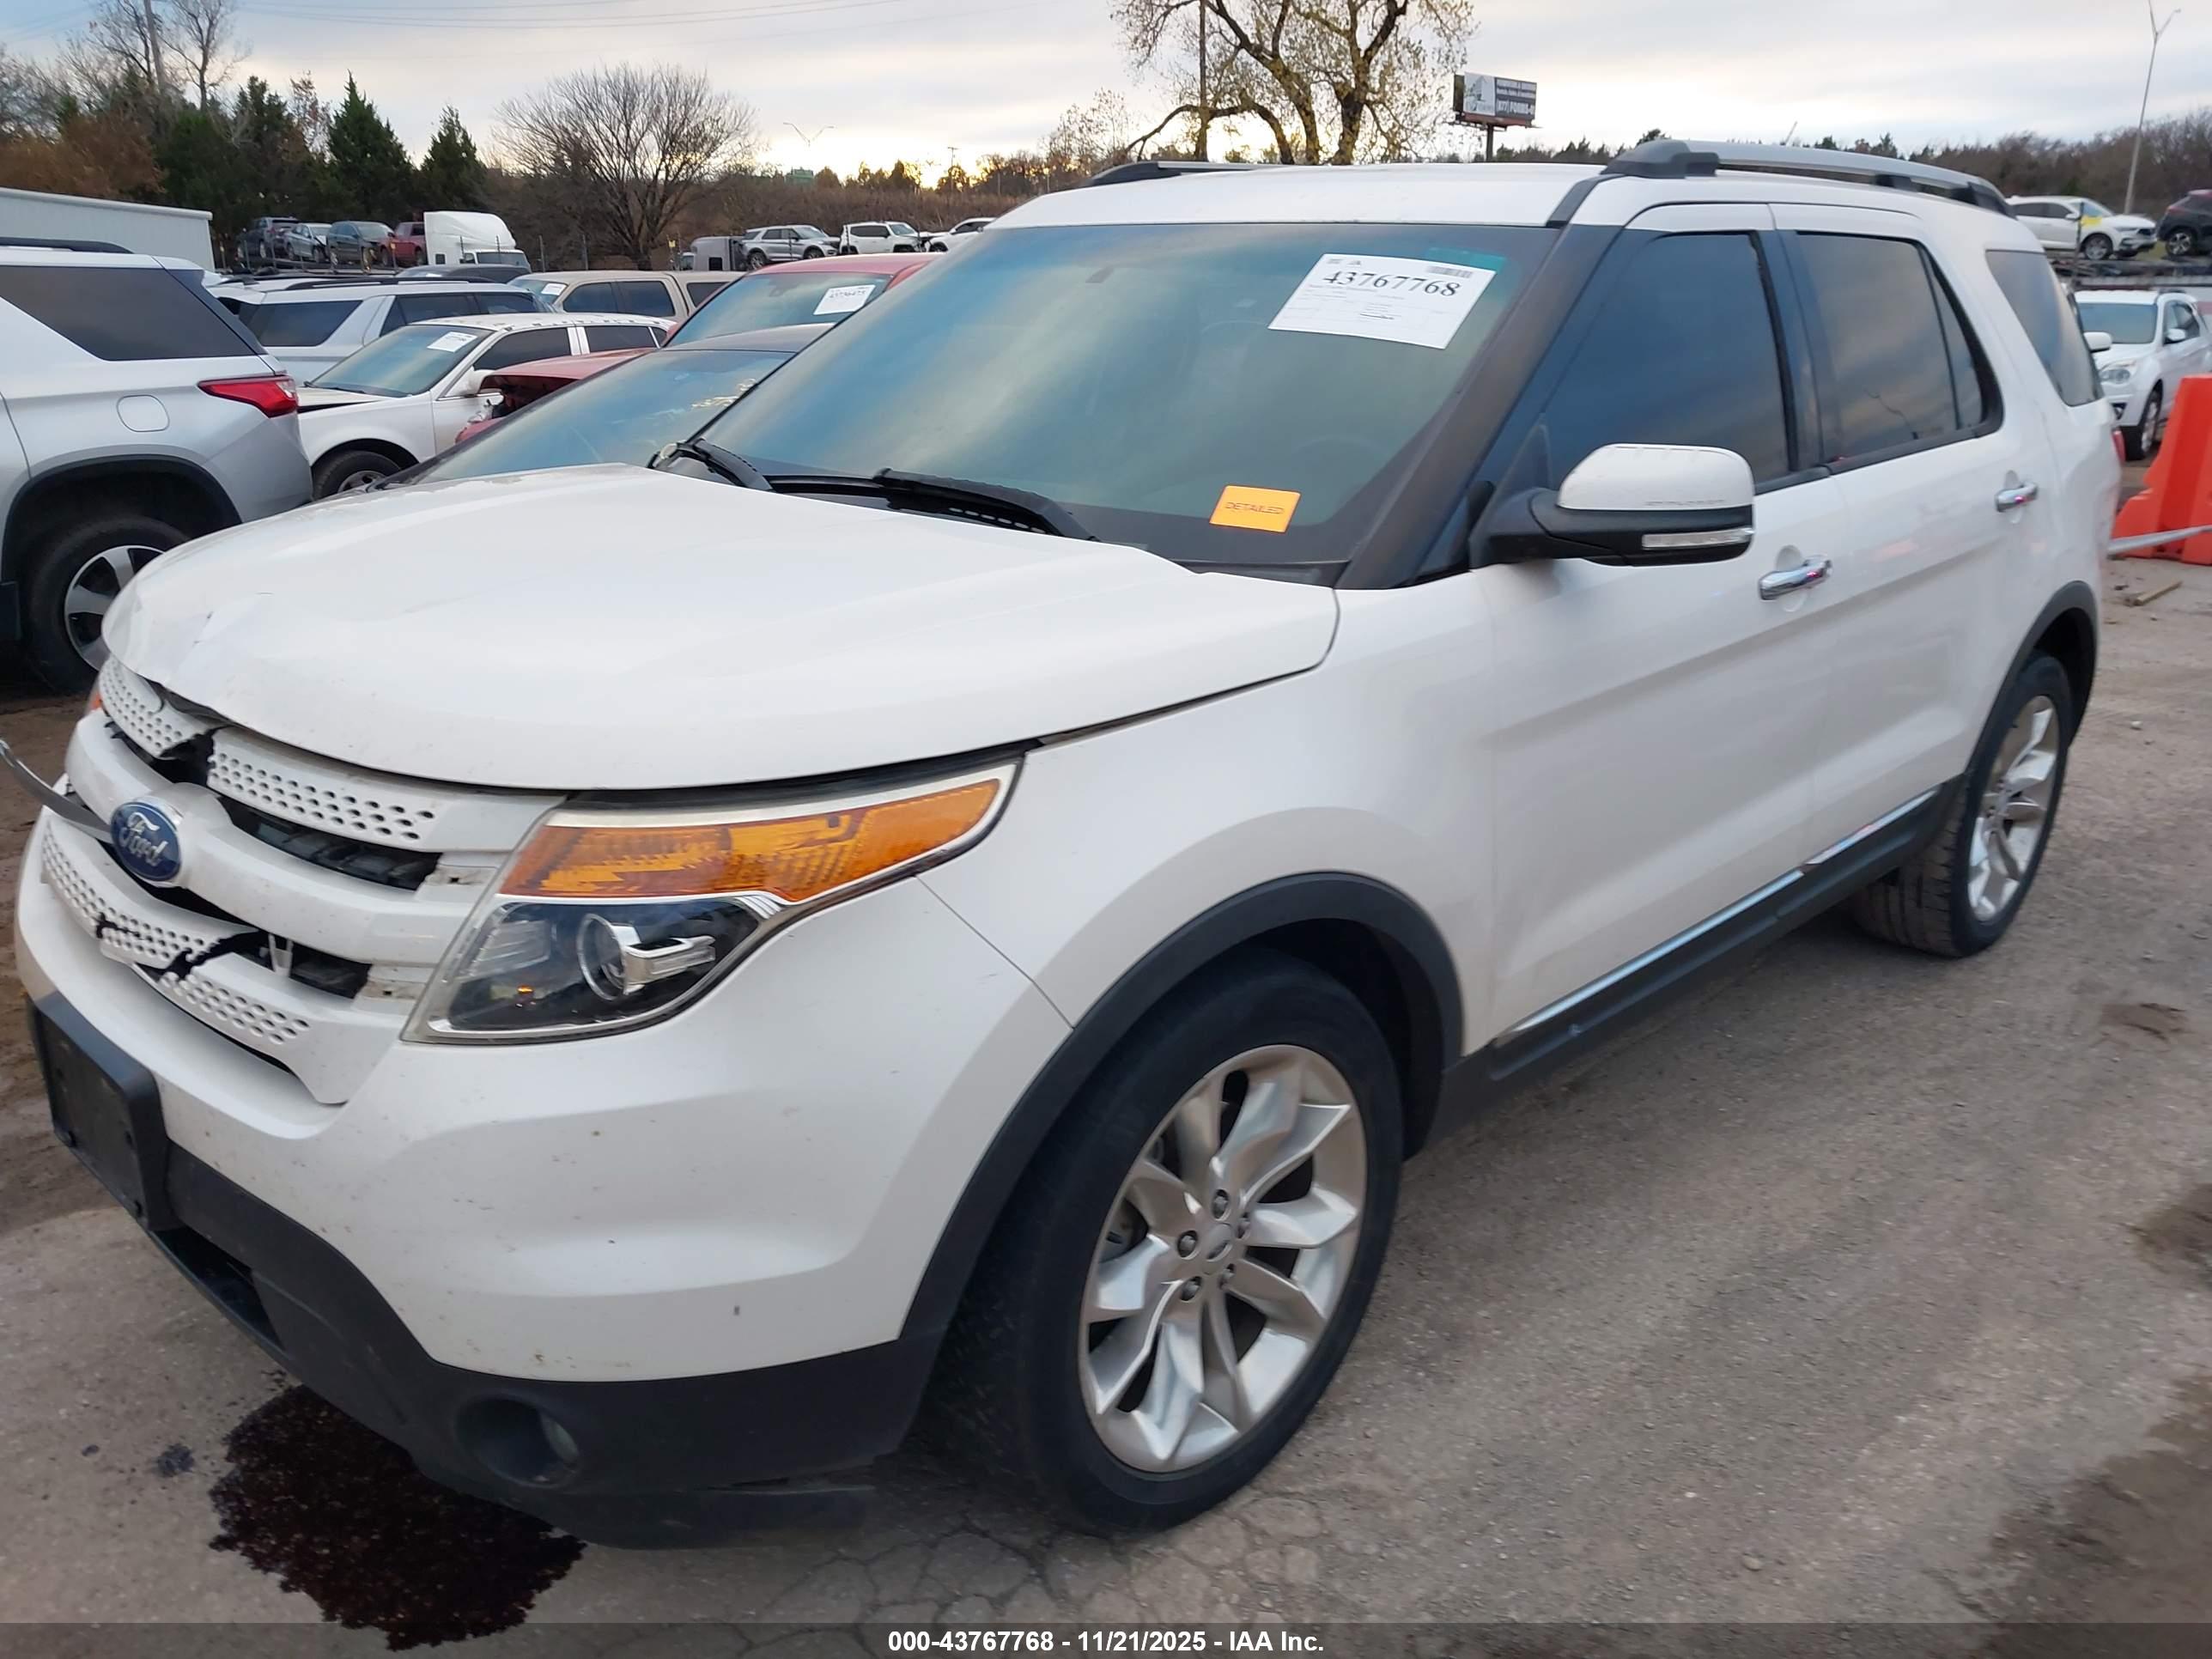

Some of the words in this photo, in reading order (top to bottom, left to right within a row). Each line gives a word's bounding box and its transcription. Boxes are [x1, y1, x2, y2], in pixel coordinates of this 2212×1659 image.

[1322, 270, 1461, 297] 43767768
[1224, 501, 1285, 515] DETAILED
[119, 811, 169, 867] Ford
